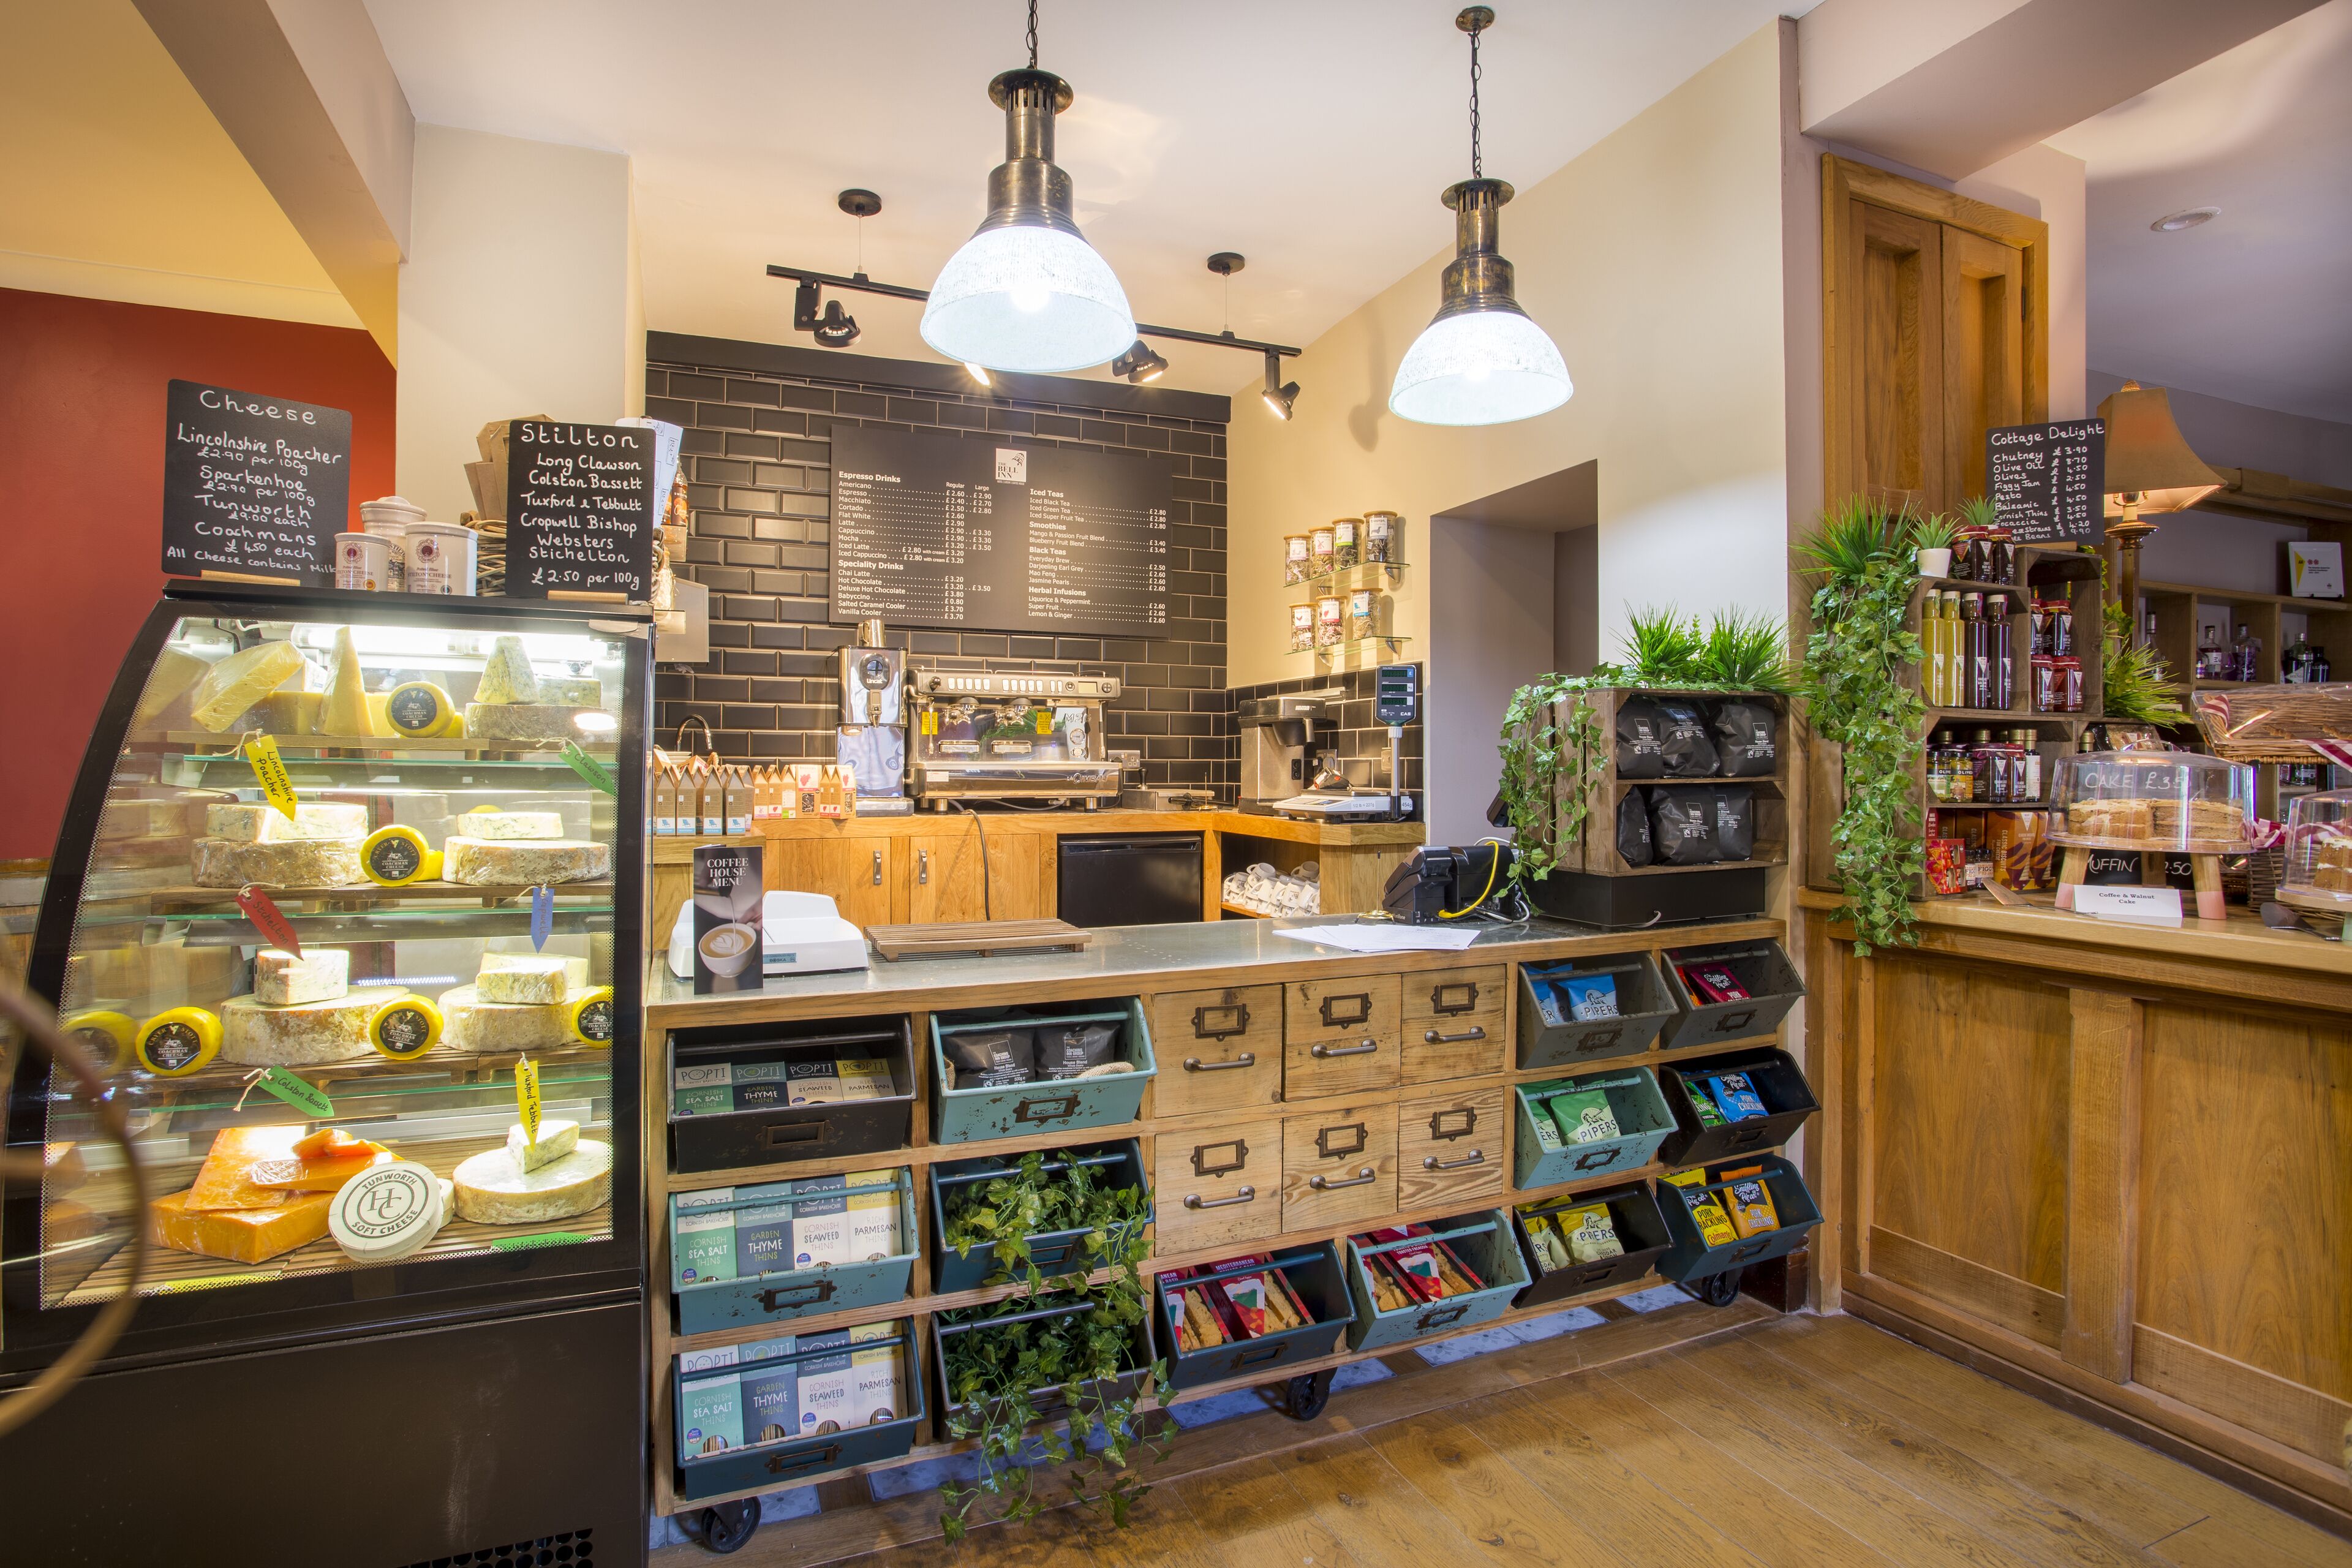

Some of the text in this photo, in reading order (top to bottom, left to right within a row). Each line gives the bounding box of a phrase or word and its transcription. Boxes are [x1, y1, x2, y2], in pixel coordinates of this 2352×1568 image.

[200, 390, 316, 424] Cheese
[521, 423, 639, 448] Stilton
[1991, 423, 2105, 447] Cottage Delight
[177, 423, 342, 464] Lincolnshire Poacher
[197, 447, 307, 476] £2.90 per 100g
[1993, 451, 2043, 463] Chutney
[537, 453, 642, 475] Long Clawson
[200, 465, 307, 492] Sparkenhoe
[529, 470, 643, 489] Colston Bassett
[839, 471, 901, 483] Espresso Drinks
[1994, 472, 2027, 481] Olives
[839, 481, 872, 489] Americano
[1994, 482, 2021, 491] Figgy
[203, 481, 315, 507] £2.90 per 100g
[839, 488, 867, 497] Espresso
[194, 494, 311, 519] Tunworth
[521, 491, 575, 508] Tuxford
[592, 496, 642, 511] Tebbutt
[1995, 501, 2039, 511] Balsamic
[274, 518, 309, 529] each
[521, 513, 638, 538] Cropwell Bishop
[1029, 521, 1066, 530] Smoothies
[195, 522, 317, 546] Coachmans
[838, 527, 875, 536] Cappuccino
[537, 533, 614, 549] Websters
[224, 539, 238, 553] £
[274, 547, 314, 560] each
[529, 546, 630, 564] Stichelton
[167, 546, 336, 573] All Cheese contains Milk
[838, 560, 876, 569] Speciality
[532, 567, 639, 590] £ 2.50 per 100g
[838, 592, 870, 601] Babyccino
[574, 752, 606, 784] Clawson
[267, 751, 293, 804] Lincolnshire
[2084, 772, 2133, 788] CAKE
[707, 858, 749, 868] COFFEE
[709, 867, 746, 878] HOUSE
[712, 877, 743, 887] MENU
[1584, 1005, 1618, 1017] PIPERS
[736, 1066, 780, 1079] POPTI
[790, 1063, 832, 1076] POPTI
[842, 1061, 884, 1072] POPTI
[681, 1067, 726, 1080] POPTI
[1581, 1120, 1618, 1142] PIPERS
[361, 1172, 418, 1191] TUNWORTH
[867, 1215, 884, 1224] RICH
[1697, 1207, 1714, 1220] PORK
[1749, 1208, 1762, 1218] PORK
[352, 1209, 418, 1235] SOFT CHEESE
[804, 1222, 840, 1234] CORNISH
[1697, 1215, 1728, 1231] RACKLING
[1747, 1216, 1774, 1229] CRACKLING
[751, 1230, 780, 1240] GARDEN
[854, 1223, 897, 1236] PARMESAN
[690, 1235, 727, 1248] CORNISH
[804, 1231, 840, 1244] SEAWEED
[1707, 1231, 1732, 1245] Colman's
[688, 1245, 728, 1259] SEA SALT
[747, 1238, 783, 1254] THYME
[811, 1242, 834, 1251] THINS
[696, 1256, 721, 1267] THINS
[754, 1251, 778, 1262] THINS
[1215, 1258, 1255, 1272] MEDITERRANEAN
